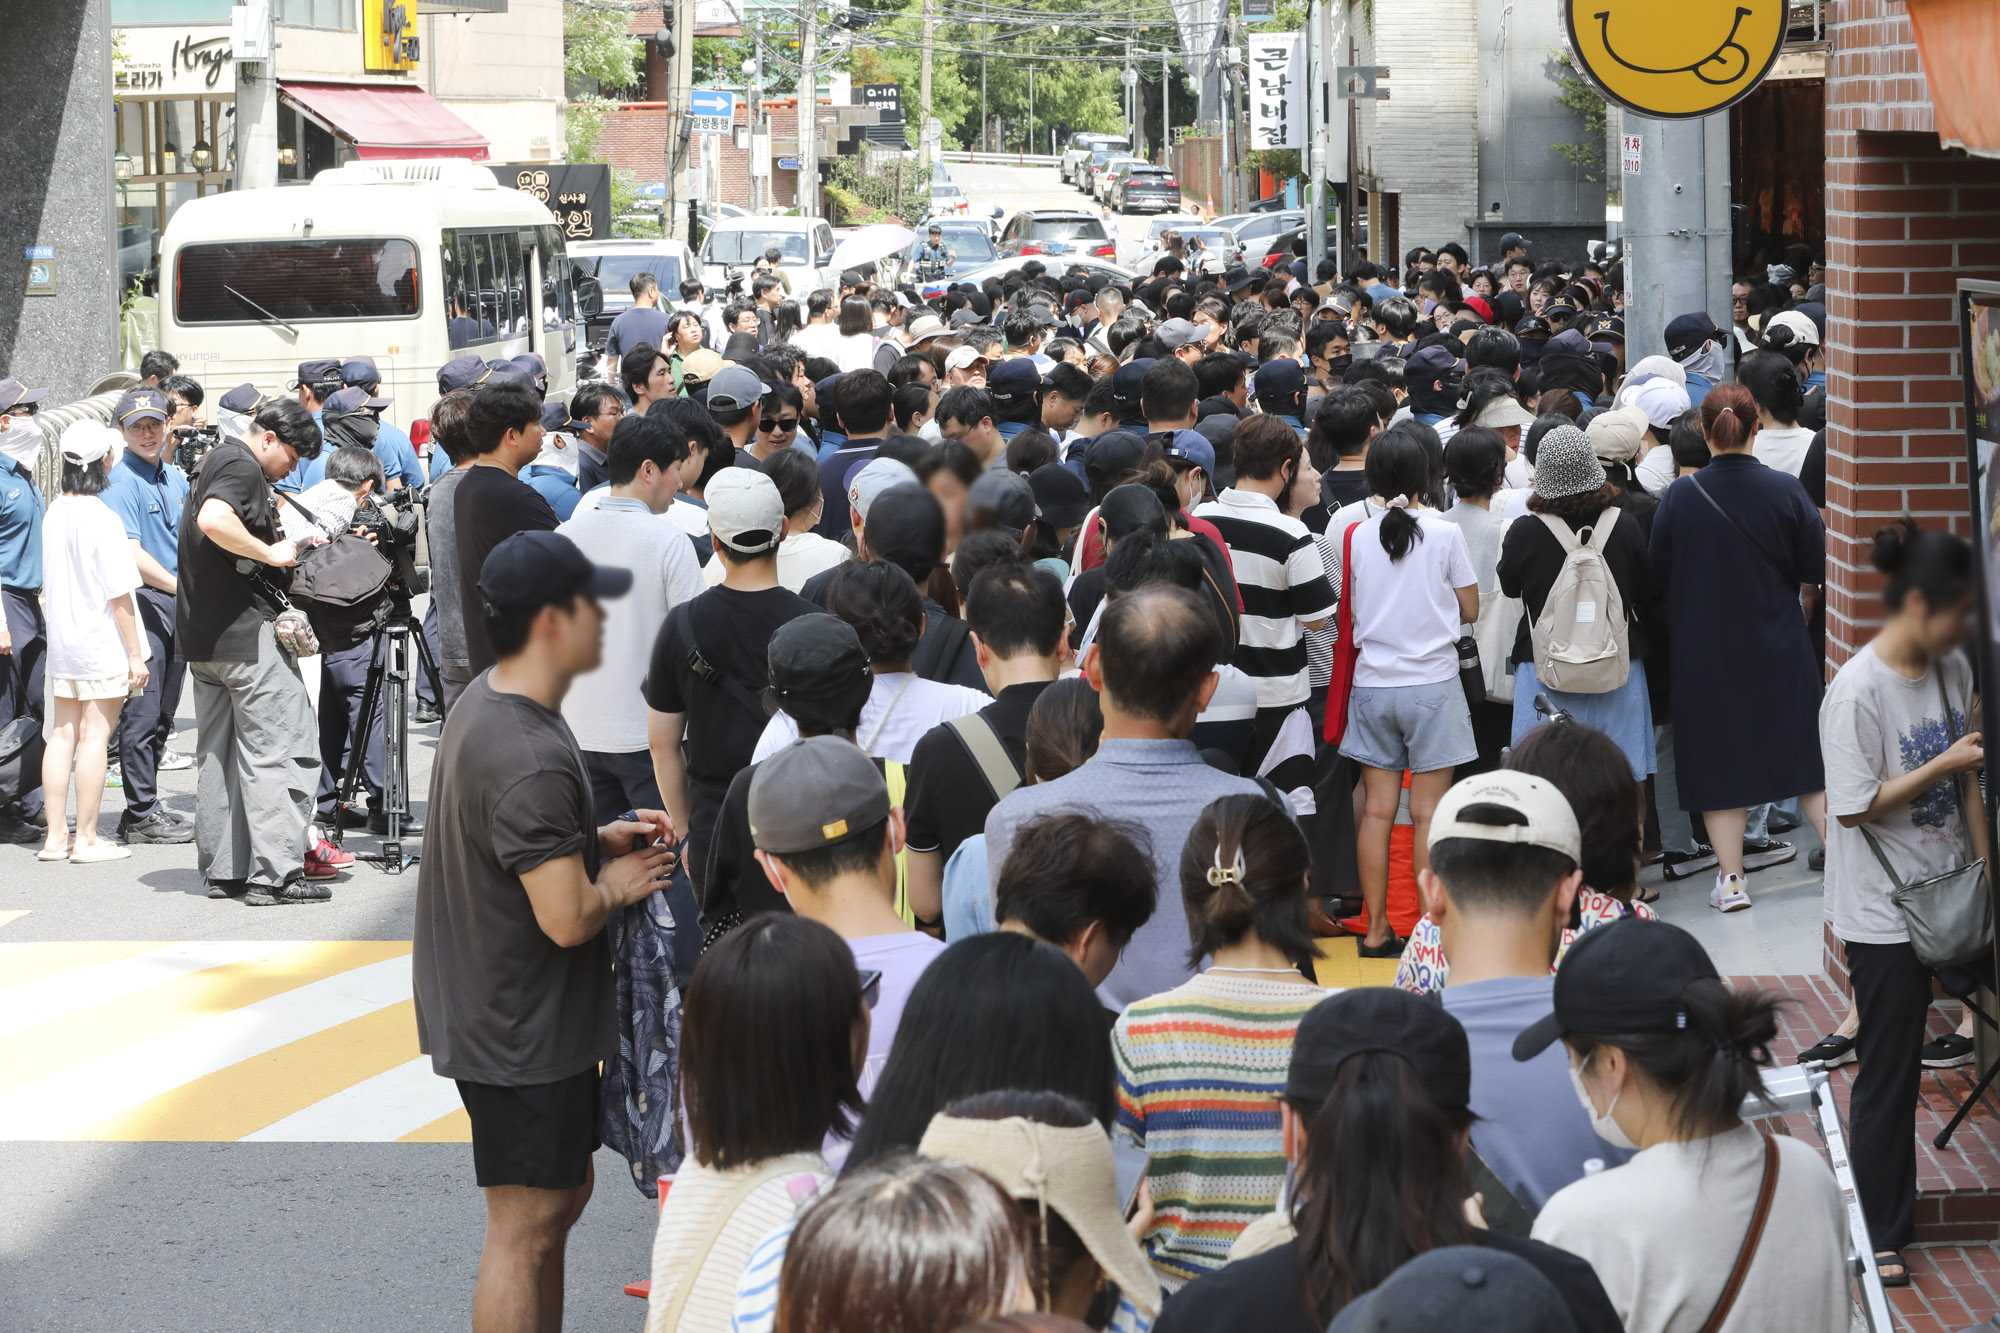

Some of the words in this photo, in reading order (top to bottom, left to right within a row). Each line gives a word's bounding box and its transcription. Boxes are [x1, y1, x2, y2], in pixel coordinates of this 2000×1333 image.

[1253, 48, 1292, 145] 큰남비집
[693, 117, 729, 130] 일방통행
[520, 176, 531, 184] 19
[175, 352, 220, 361] HYUNDAI
